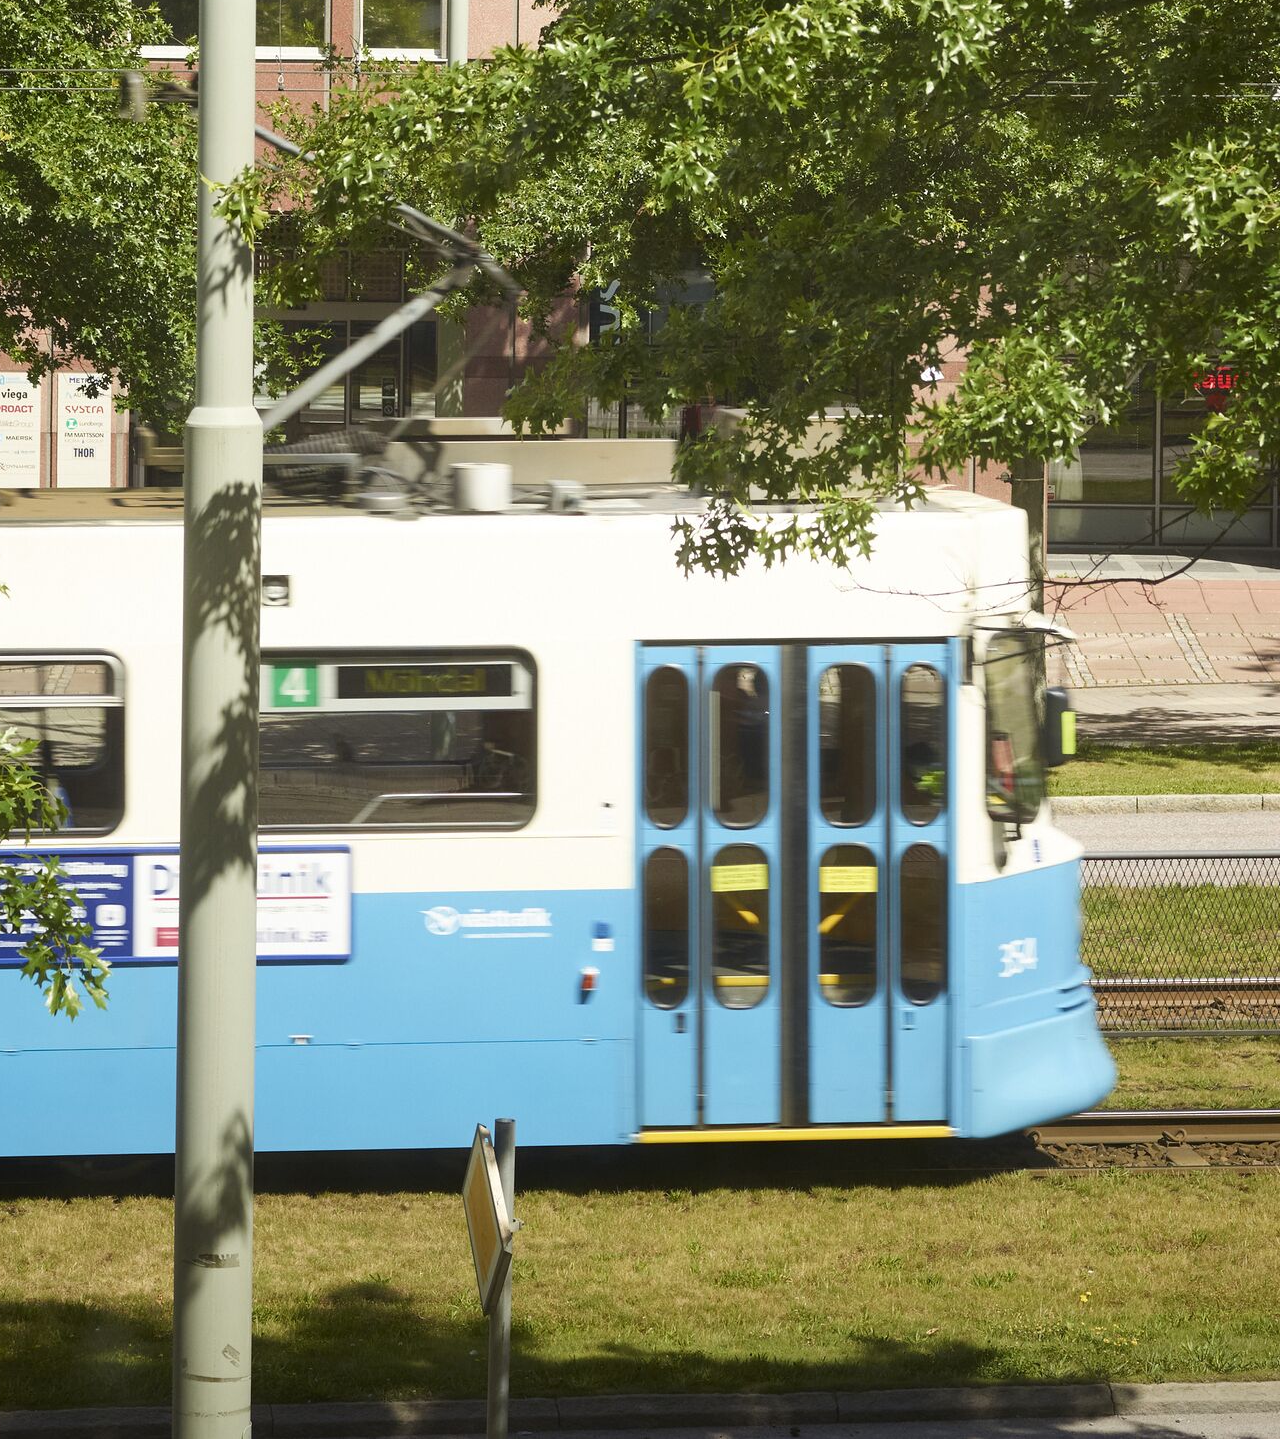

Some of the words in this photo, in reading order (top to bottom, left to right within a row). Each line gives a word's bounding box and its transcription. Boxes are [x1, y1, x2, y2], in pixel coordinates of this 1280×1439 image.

[1, 388, 28, 401] viega
[65, 405, 104, 414] SYSTRA
[73, 448, 95, 458] THOR
[279, 667, 311, 703] 4
